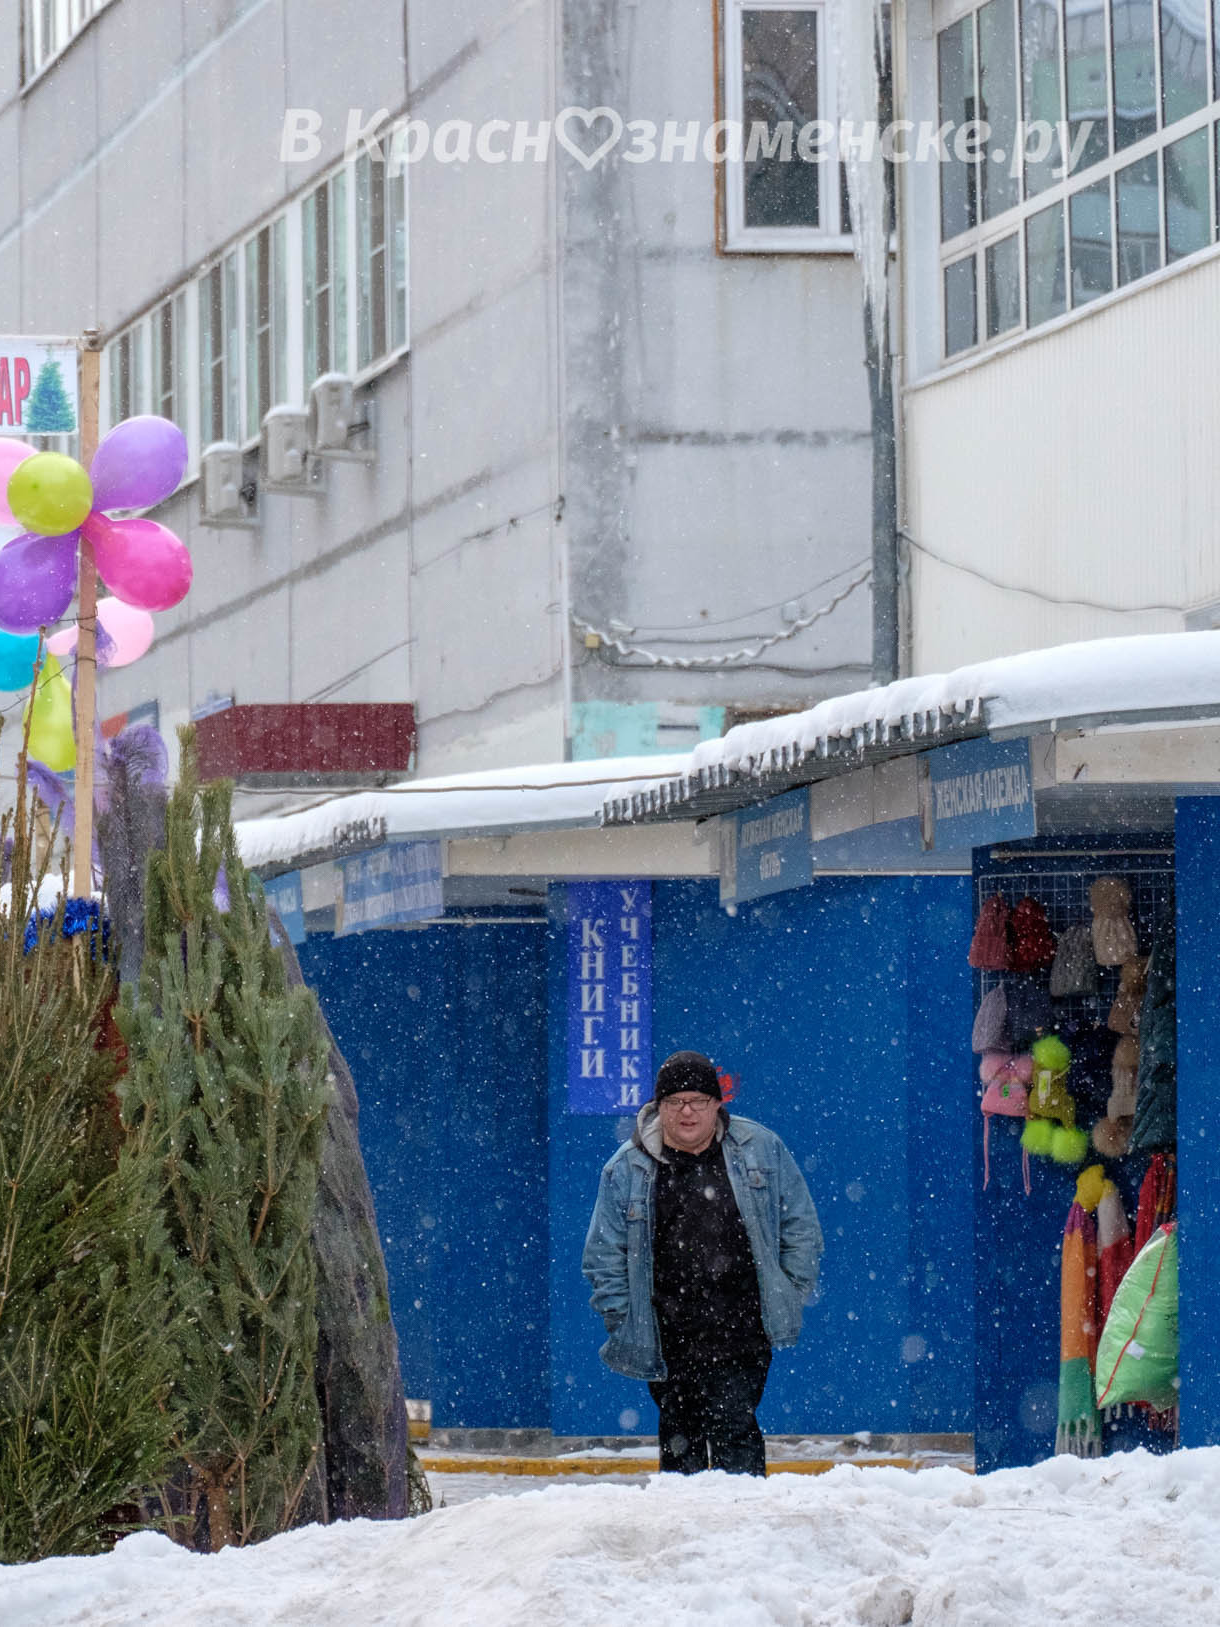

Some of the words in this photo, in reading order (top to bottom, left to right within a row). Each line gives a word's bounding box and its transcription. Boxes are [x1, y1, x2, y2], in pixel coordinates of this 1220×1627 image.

[934, 773, 983, 820] ЖЕНСКАЯ
[983, 764, 1030, 816] ОДЕЖДА
[580, 918, 606, 1078] КНИГИ
[619, 888, 641, 1107] УЧЕБНИКИ
